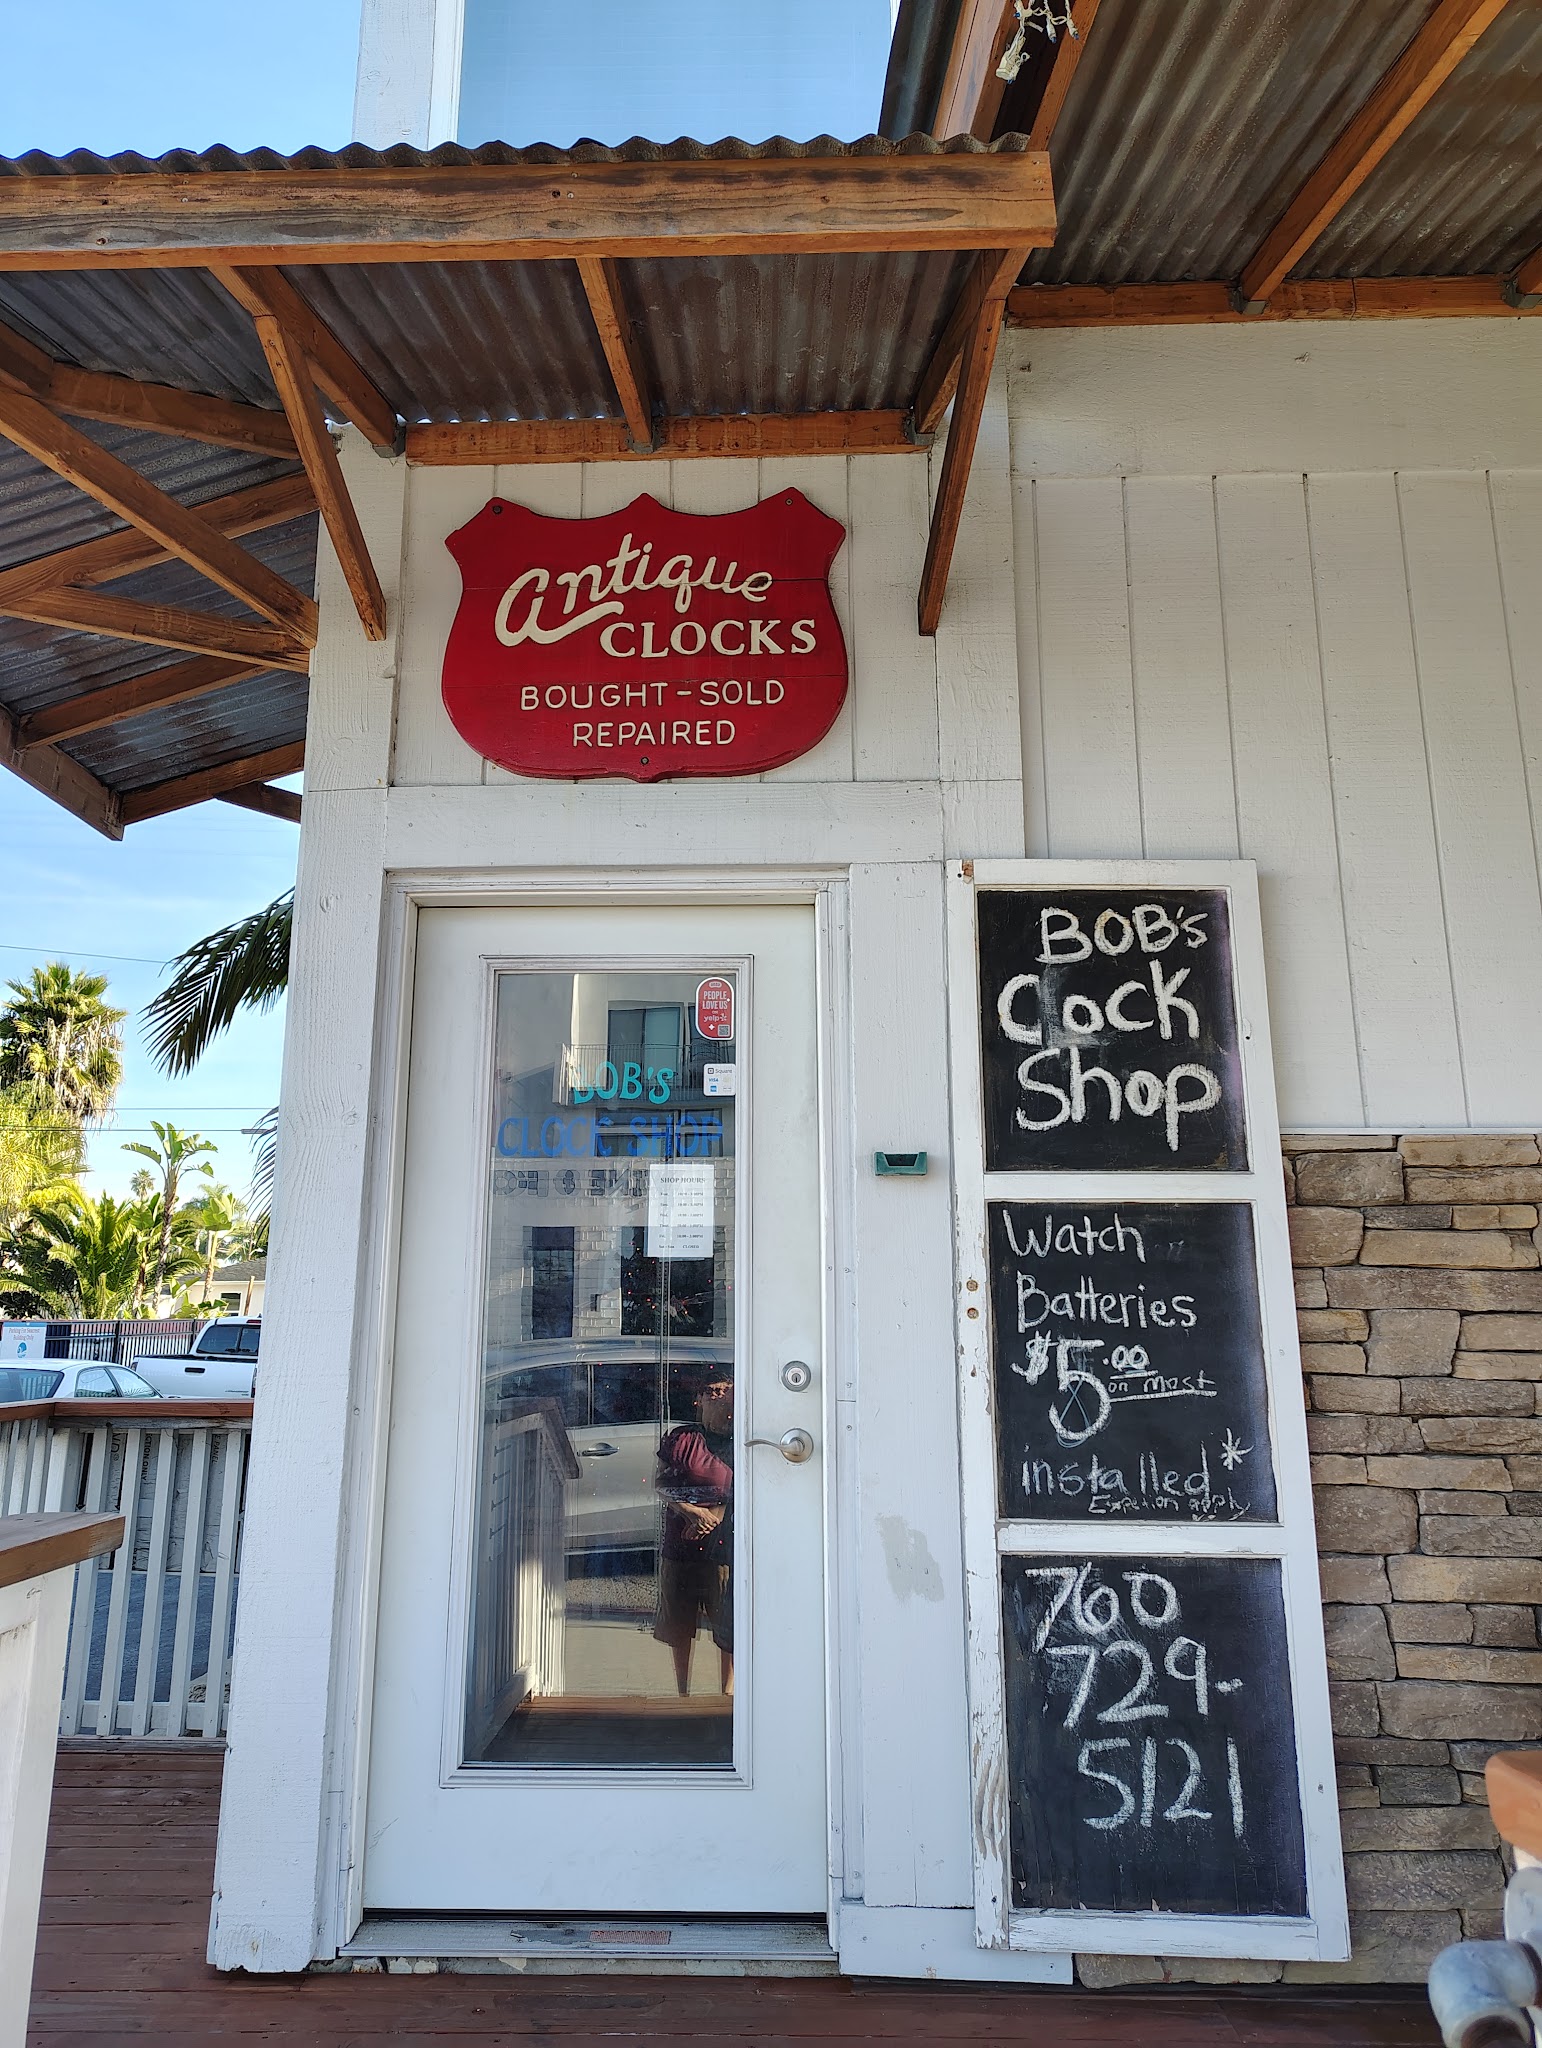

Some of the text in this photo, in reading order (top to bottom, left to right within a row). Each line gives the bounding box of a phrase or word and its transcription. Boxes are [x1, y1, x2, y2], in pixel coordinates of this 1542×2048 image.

[494, 532, 774, 647] Antique
[600, 619, 817, 658] CLOCKS
[521, 682, 668, 710] BOUGHT
[699, 680, 785, 706] SOLD
[572, 720, 736, 747] REPAIRED
[702, 1000, 728, 1010] LOVE US
[703, 990, 727, 1000] PEOPLE
[704, 1014, 720, 1022] yelp
[573, 1061, 674, 1104] BOB'S
[1015, 1046, 1222, 1152] Shop
[497, 1115, 724, 1157] CLOCK SHOP
[1002, 1209, 1147, 1263] Watch
[1016, 1270, 1198, 1334] Batteries
[1077, 1736, 1246, 1838] 5121
